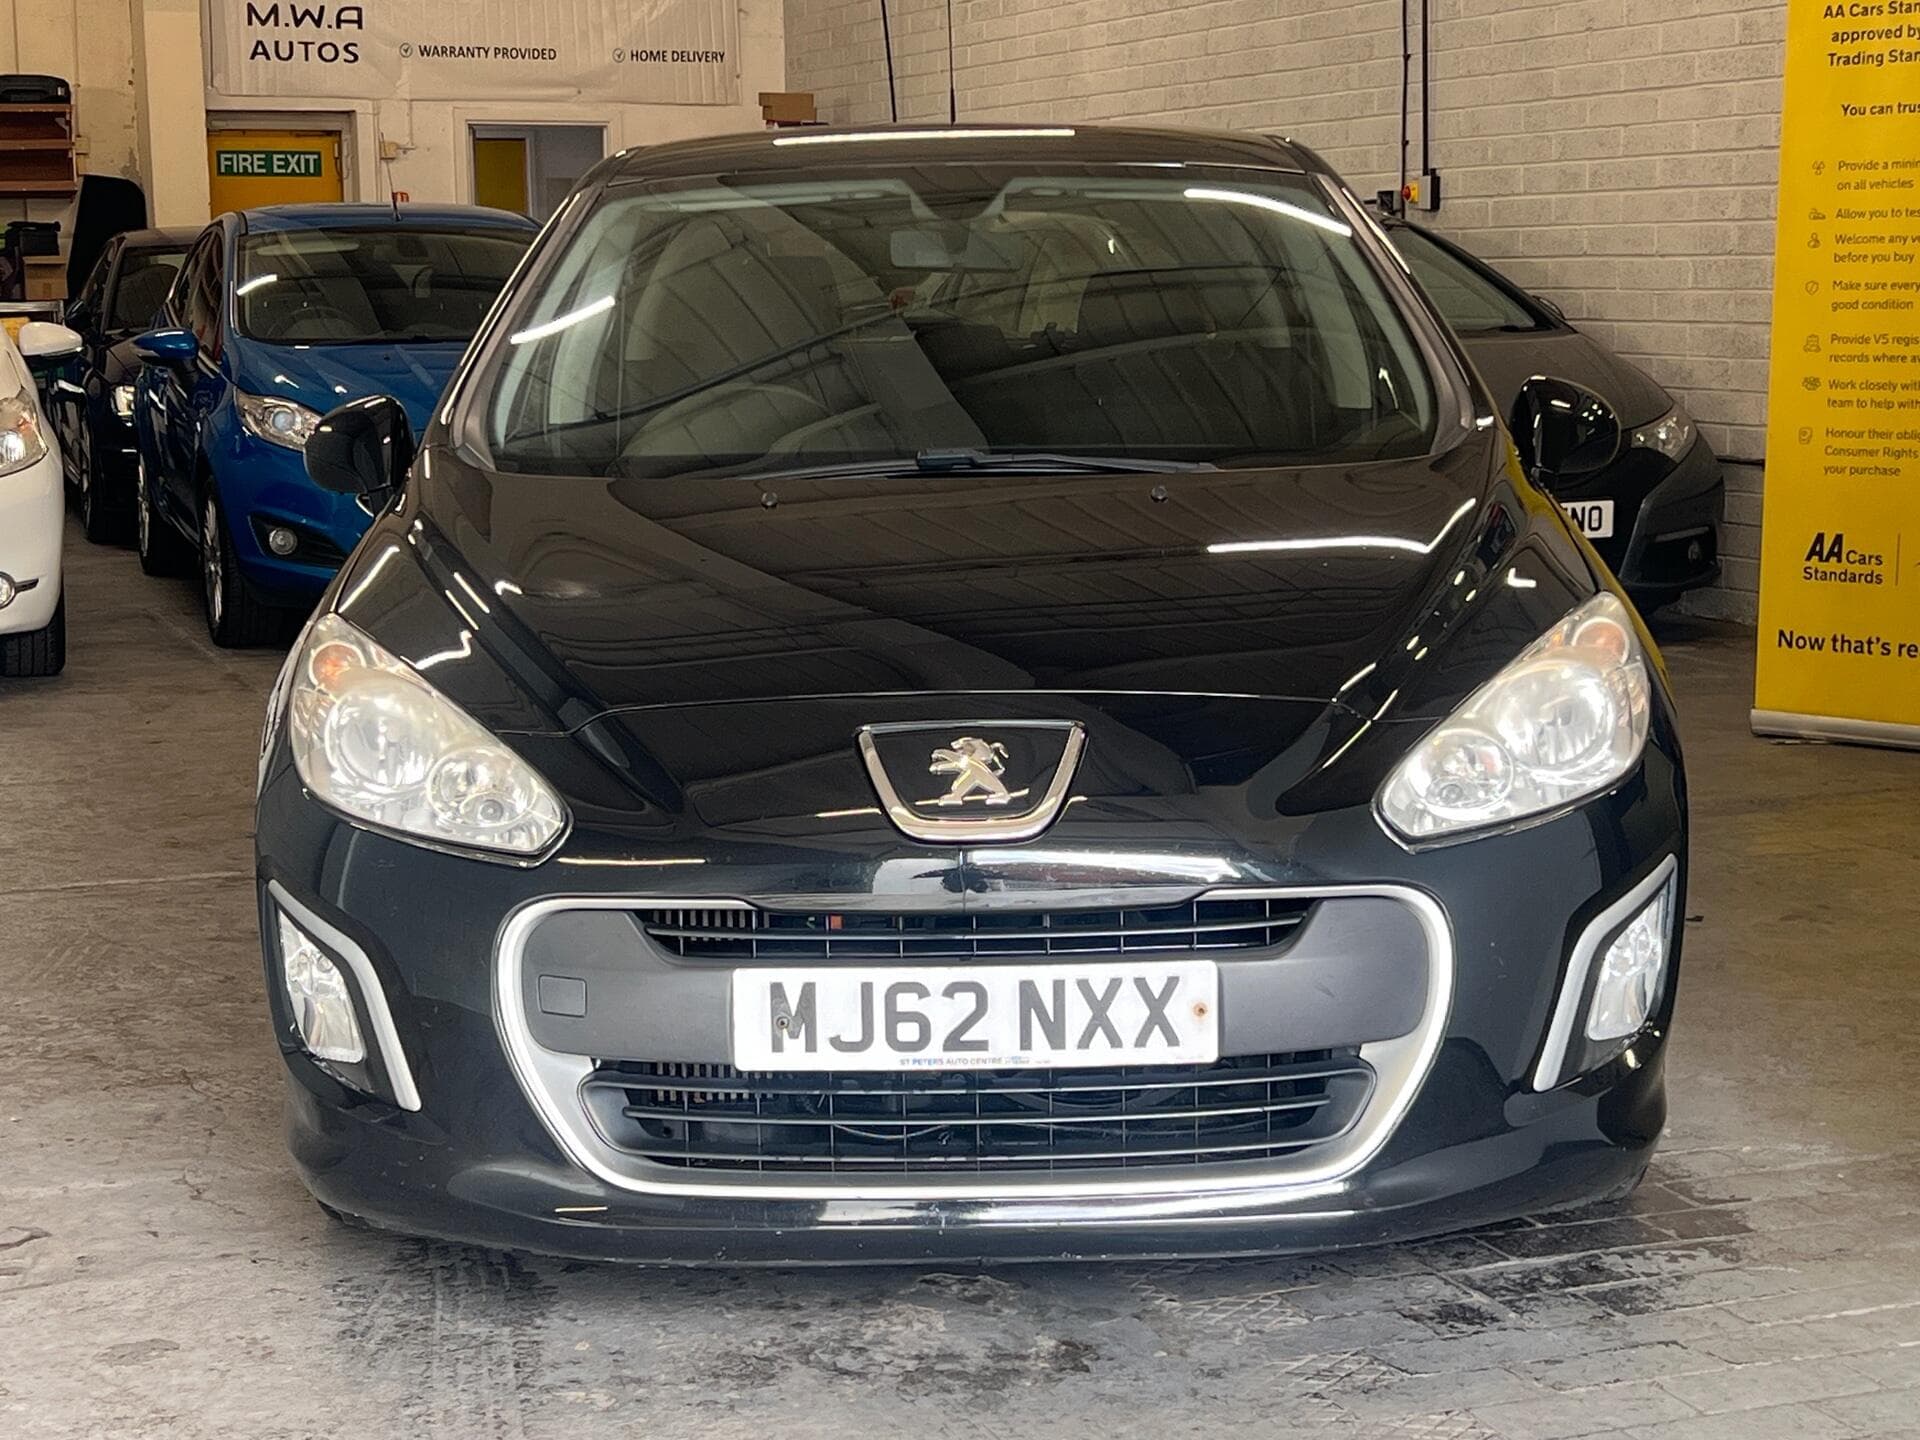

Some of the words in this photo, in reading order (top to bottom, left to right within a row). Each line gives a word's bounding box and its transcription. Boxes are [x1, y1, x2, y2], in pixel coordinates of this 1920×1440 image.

[246, 2, 363, 30] M.W.A
[1824, 4, 1845, 19] AA
[1849, 3, 1884, 17] Cars
[1831, 24, 1903, 44] approved
[249, 40, 359, 64] AUTOS
[418, 44, 490, 60] WARRANTY
[494, 46, 557, 61] PROVIDED
[630, 49, 667, 63] HOME
[671, 50, 725, 64] DELIVERY
[1828, 50, 1884, 67] Trading
[1841, 104, 1866, 116] You
[1870, 104, 1893, 115] can
[220, 153, 267, 174] FIRE
[273, 153, 319, 174] EXIT
[1838, 160, 1880, 171] Provide
[1882, 161, 1889, 170] a
[1837, 181, 1851, 191] on
[1854, 180, 1867, 190] all
[1869, 178, 1914, 189] vehicles
[1836, 208, 1866, 219] Allow
[1869, 209, 1888, 220] you
[1891, 208, 1902, 218] to
[1835, 233, 1885, 244] Welcome
[1888, 235, 1908, 246] any
[1834, 252, 1869, 263] before
[1871, 253, 1890, 264] you
[1894, 251, 1914, 264] buy
[1832, 280, 1861, 291] Make
[1864, 281, 1887, 290] sure
[1890, 282, 1920, 293] every
[1831, 300, 1859, 312] good
[1861, 299, 1914, 310] condition
[1830, 333, 1871, 344] Provide
[1873, 333, 1889, 344] V5
[1892, 333, 1919, 347] regis
[1829, 352, 1870, 363] records
[1872, 352, 1907, 363] where
[1828, 379, 1856, 390] Work
[1859, 380, 1897, 393] closely
[1827, 398, 1853, 408] team
[1856, 398, 1867, 408] to
[1870, 397, 1894, 410] help
[1825, 427, 1866, 439] Honour
[1868, 428, 1893, 440] their
[1824, 445, 1880, 457] Consumer
[1883, 446, 1919, 460] Rights
[1824, 465, 1847, 476] your
[1849, 465, 1901, 477] purchase
[1564, 506, 1603, 532] NO
[1805, 532, 1844, 564] AA
[1846, 550, 1883, 566] Cars
[1803, 566, 1884, 585] Standards
[1778, 629, 1825, 651] Now
[1831, 634, 1891, 657] that's
[770, 981, 990, 1053] MJ62
[1019, 976, 1181, 1050] NXX
[900, 1058, 910, 1066] ST
[912, 1058, 944, 1066] PETERS
[970, 1057, 1002, 1065] CENTRE
